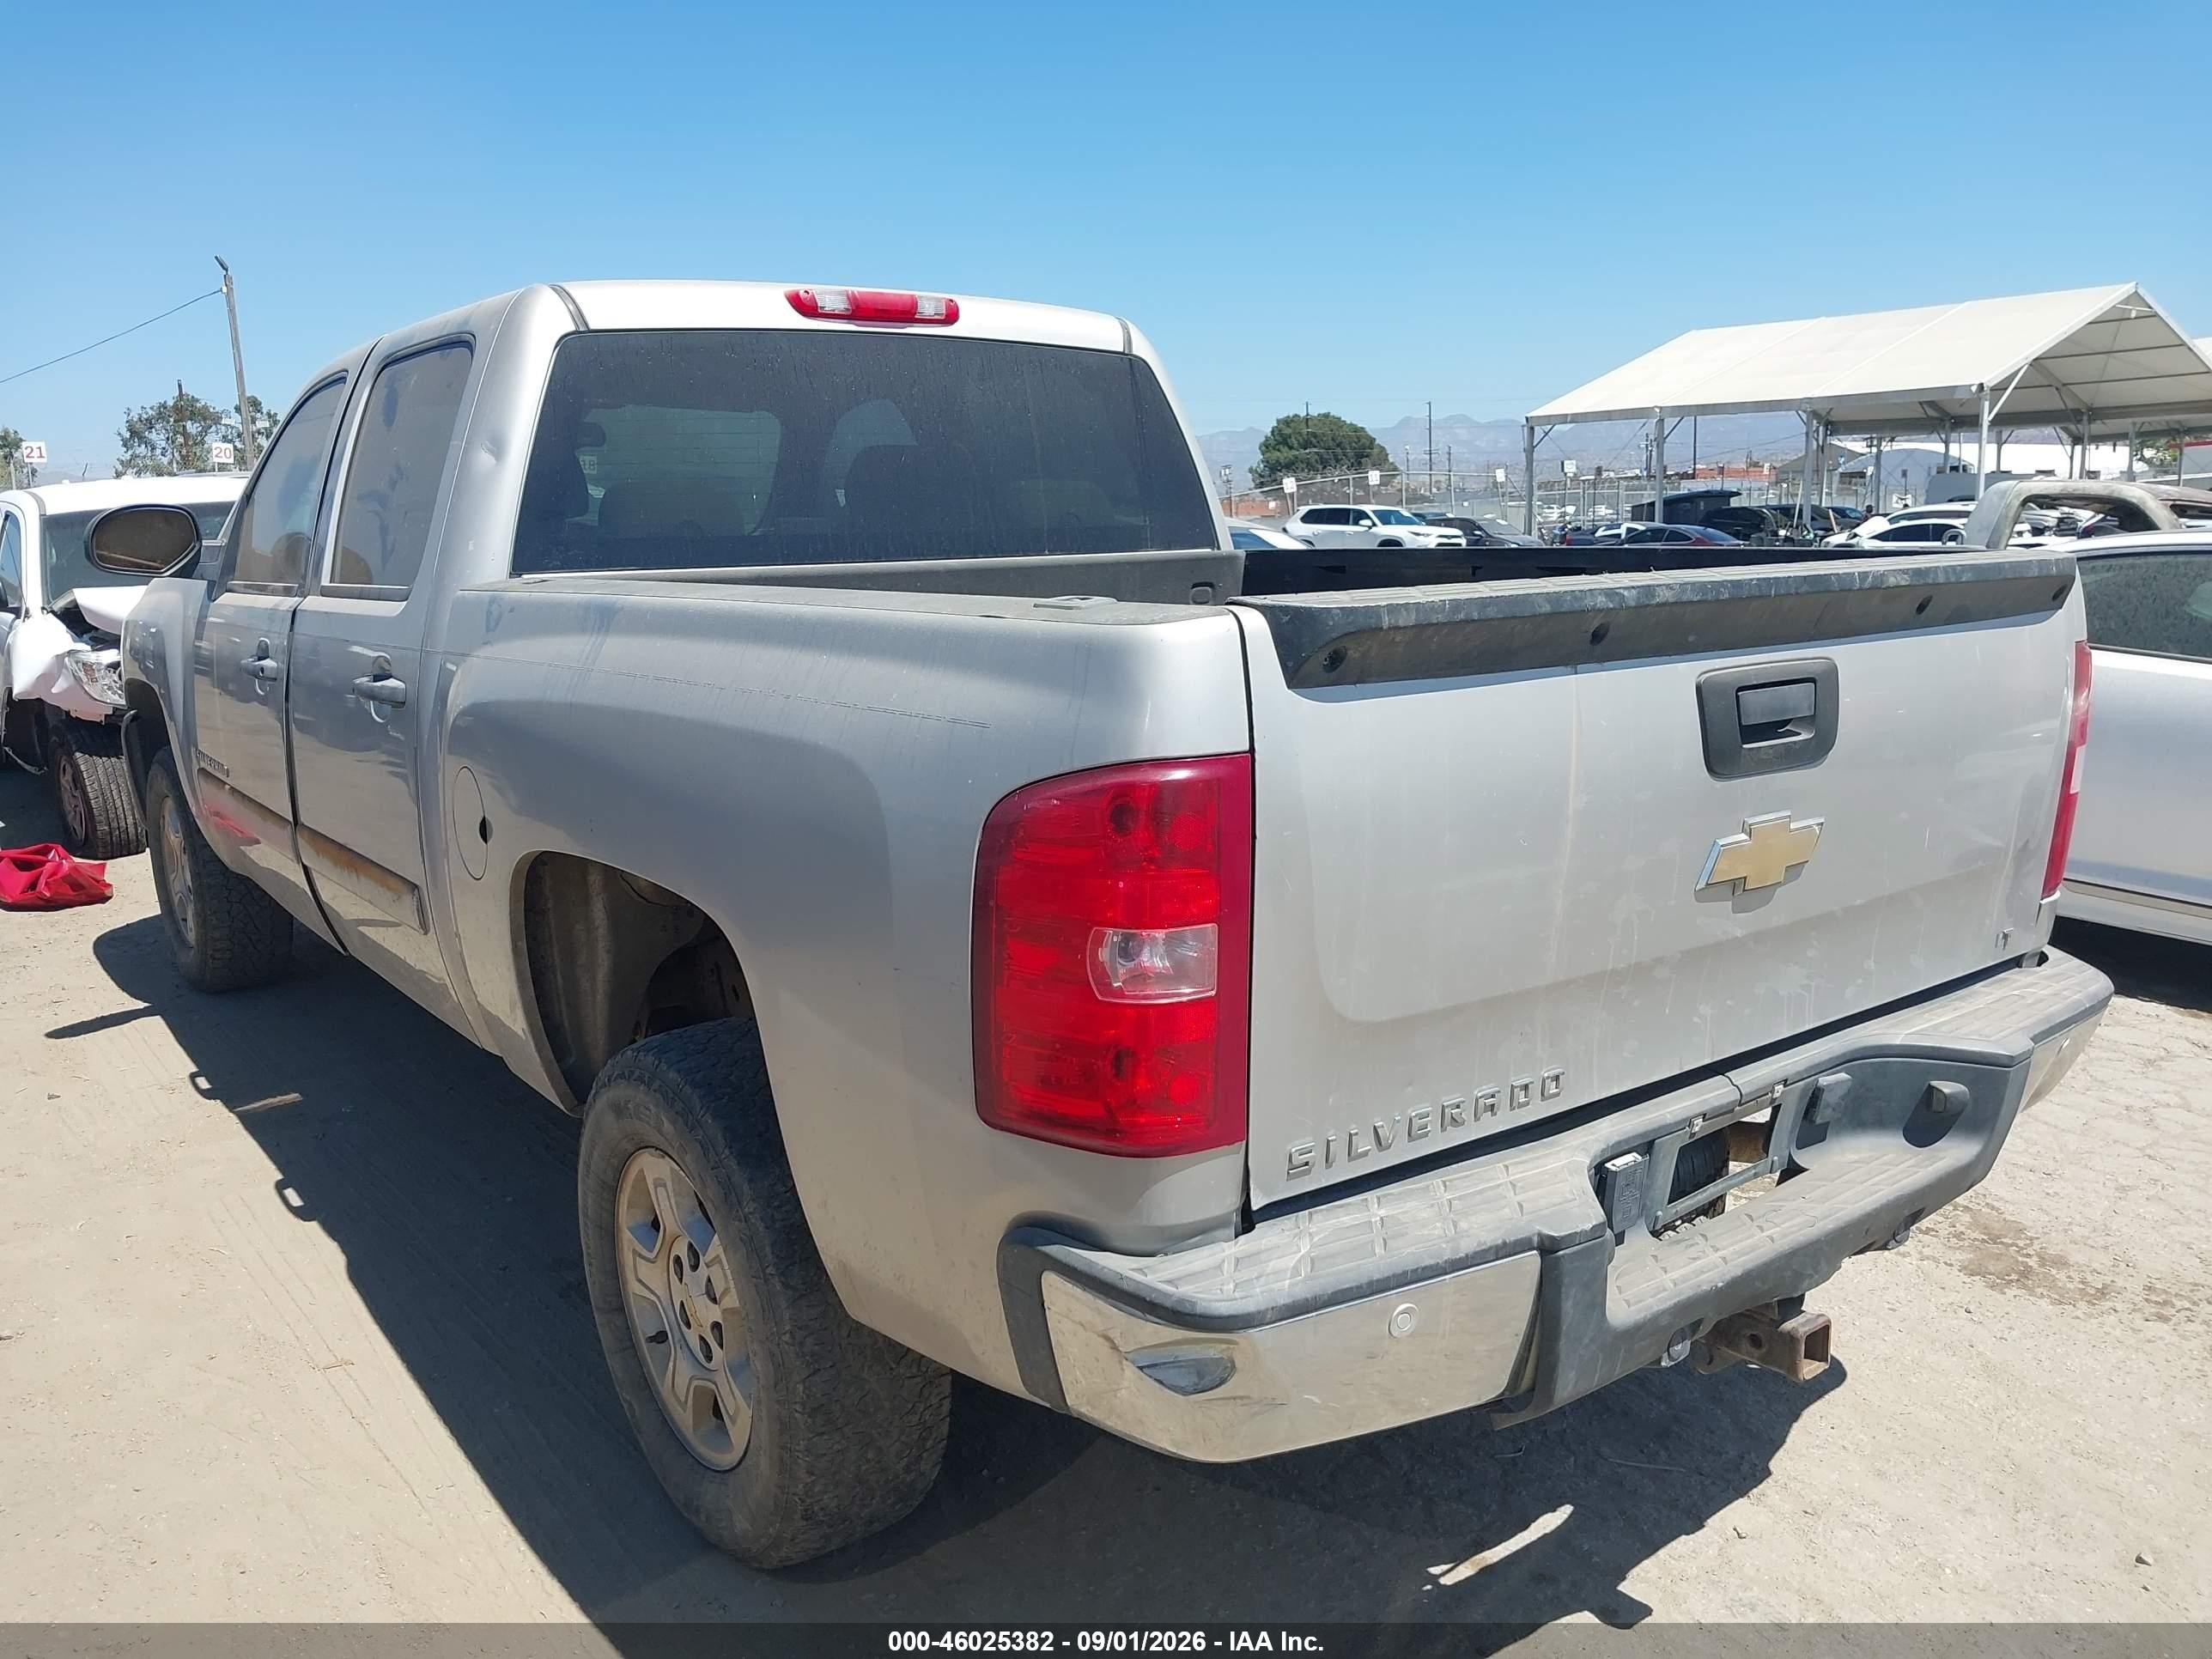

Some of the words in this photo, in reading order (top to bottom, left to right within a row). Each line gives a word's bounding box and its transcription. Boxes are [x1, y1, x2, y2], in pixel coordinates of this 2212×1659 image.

[24, 445, 46, 459] 21
[214, 446, 233, 459] 20
[1286, 1065, 1565, 1182] SILVERADO
